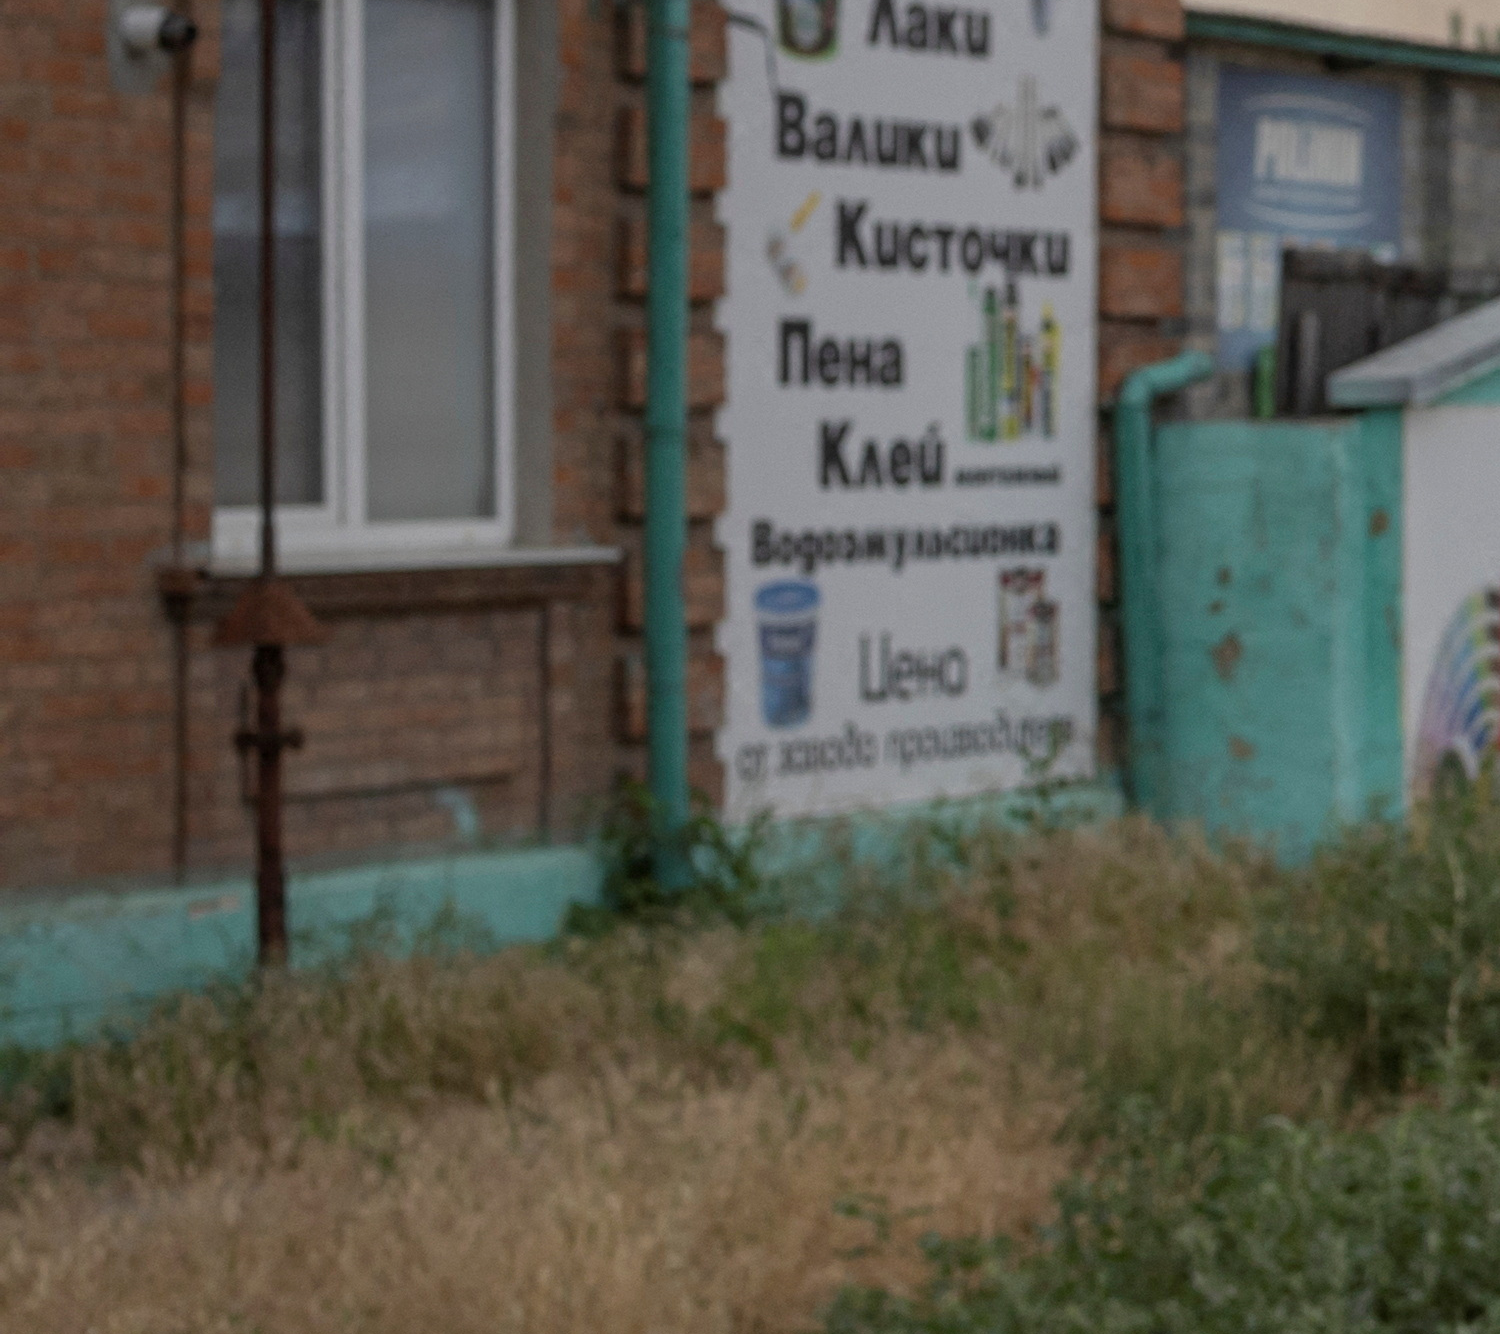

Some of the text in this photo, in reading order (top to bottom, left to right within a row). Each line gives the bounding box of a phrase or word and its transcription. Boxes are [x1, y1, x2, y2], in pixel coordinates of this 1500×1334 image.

[776, 89, 961, 172] Валики
[836, 198, 1069, 276] Кисточки
[780, 319, 905, 388] Пена
[819, 421, 947, 490] Клей
